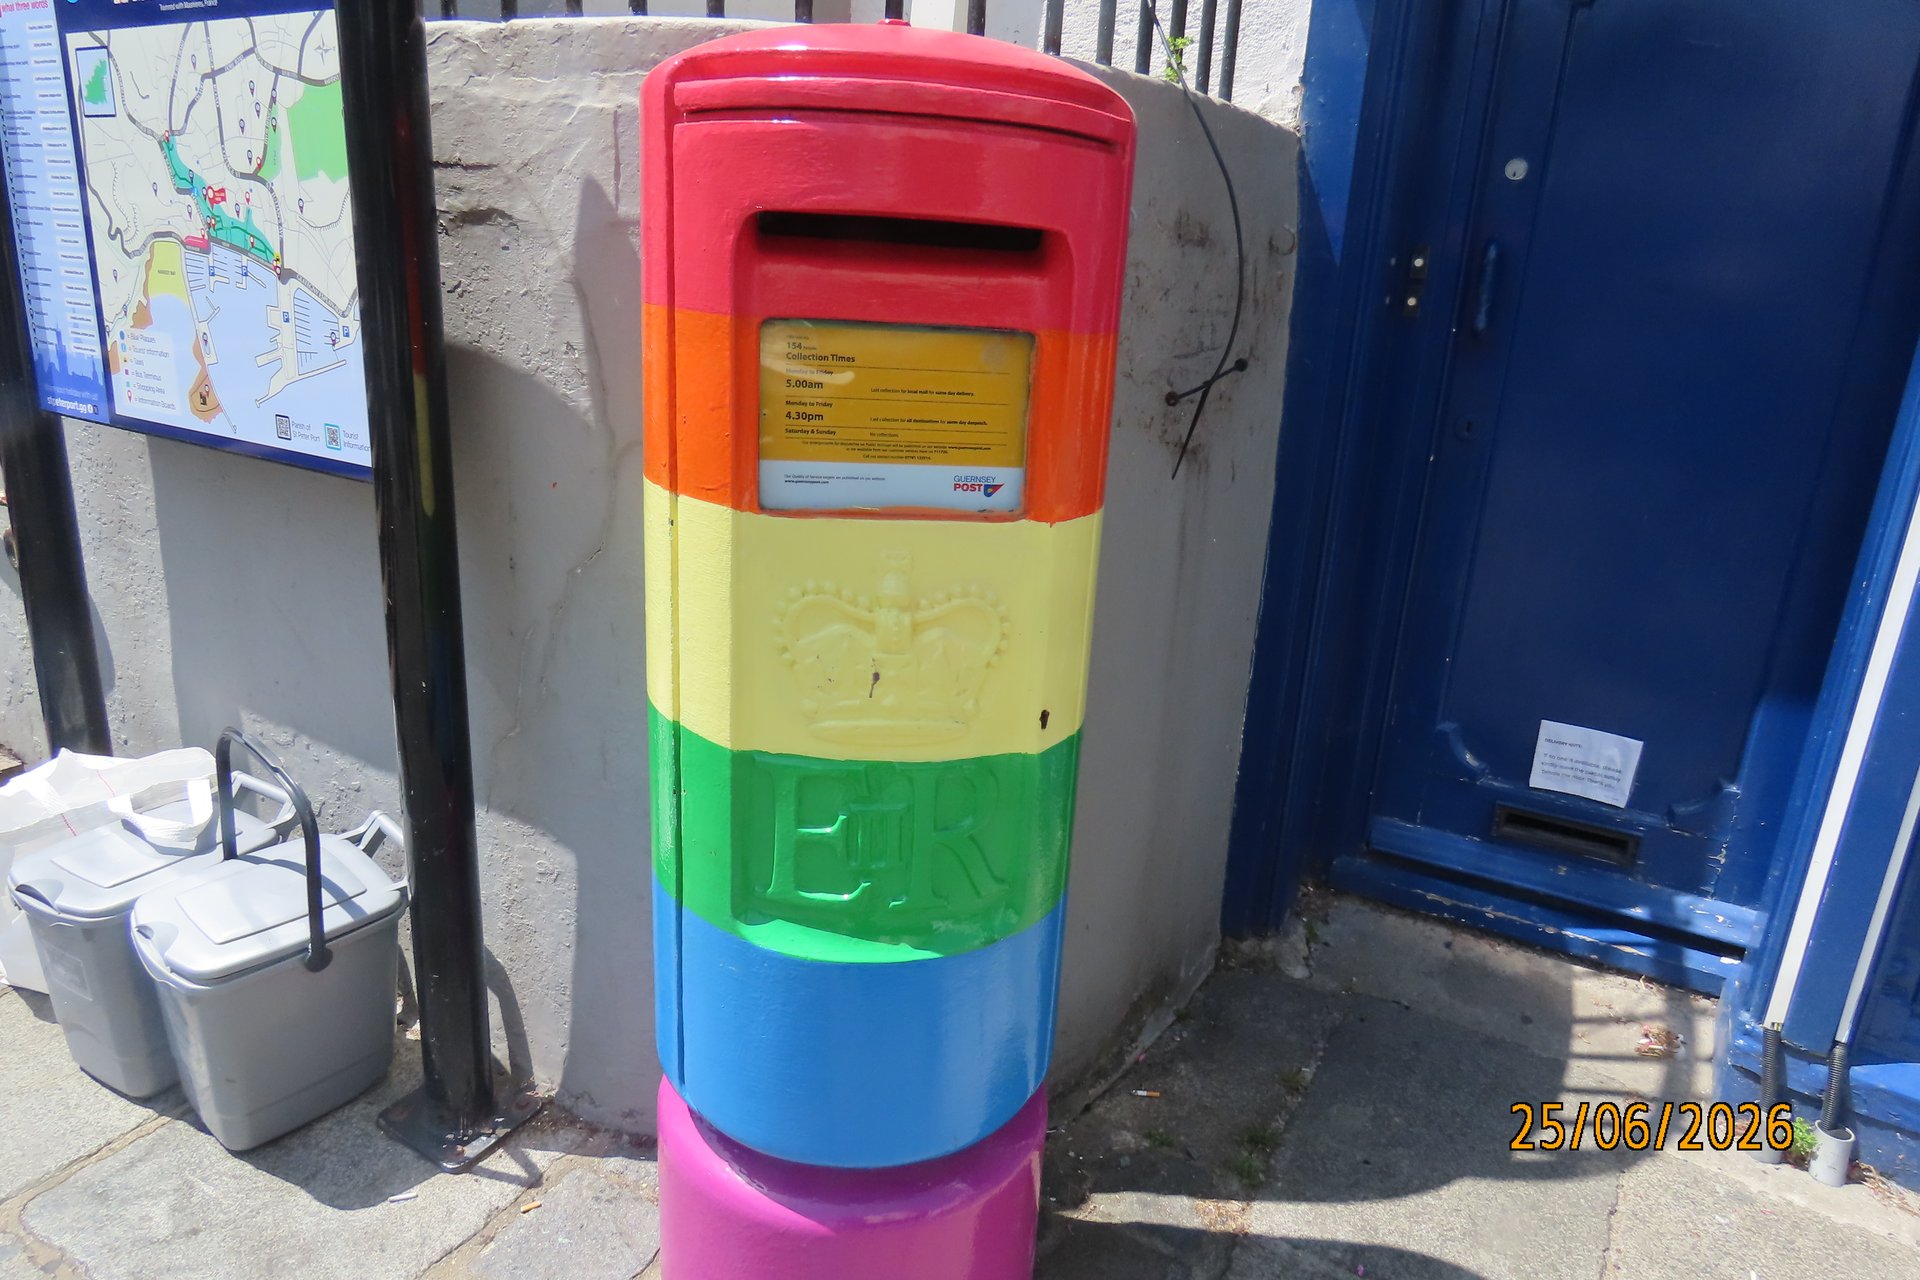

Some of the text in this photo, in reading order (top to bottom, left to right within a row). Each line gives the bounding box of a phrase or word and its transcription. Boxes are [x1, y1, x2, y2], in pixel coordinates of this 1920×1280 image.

[786, 352, 856, 362] Collection Times
[786, 380, 824, 389] 5.00am
[786, 411, 824, 422] 4.30pm
[292, 421, 305, 430] Parish
[298, 432, 309, 440] Peter
[310, 433, 320, 442] Port
[342, 430, 359, 440] Tourist
[344, 441, 370, 451] Information
[954, 475, 996, 483] GUERNSEY
[954, 483, 983, 492] POST
